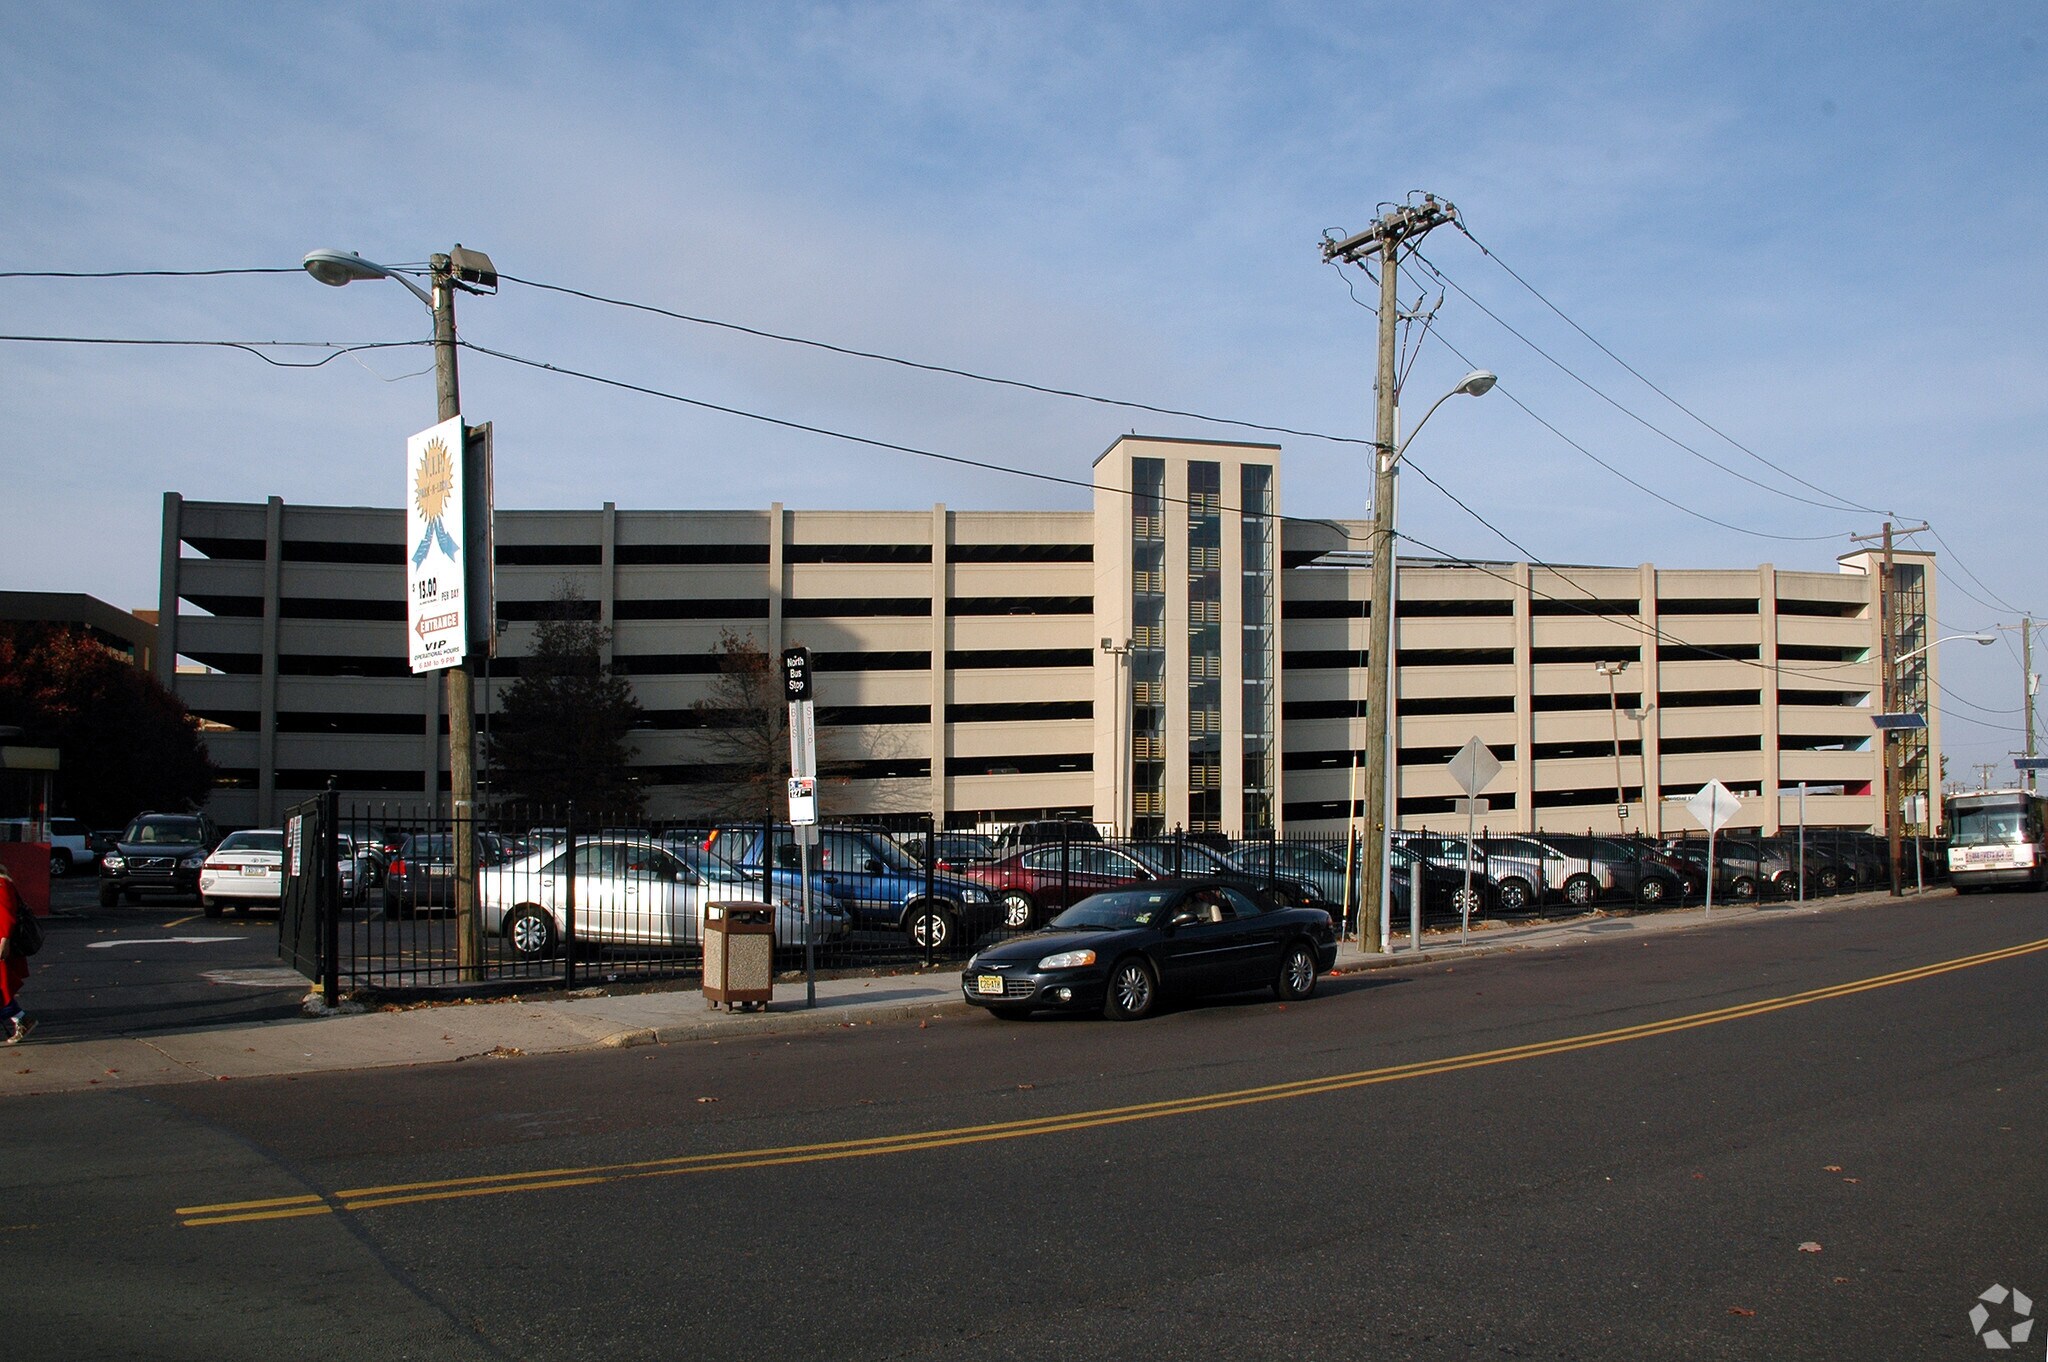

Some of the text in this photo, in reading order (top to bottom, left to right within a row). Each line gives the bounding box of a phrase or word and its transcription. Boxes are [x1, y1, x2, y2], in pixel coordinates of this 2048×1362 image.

[441, 591, 449, 601] PER
[450, 588, 459, 599] DAY
[420, 614, 457, 633] ENTRANCE
[425, 640, 446, 651] VIP
[414, 646, 460, 660] OPERATIONAL HOURS
[424, 660, 432, 668] AM
[440, 657, 445, 665] 9
[446, 656, 456, 664] PM
[787, 656, 804, 667] North
[790, 669, 802, 678] Bus
[789, 680, 804, 691] Stop
[790, 788, 802, 798] 127
